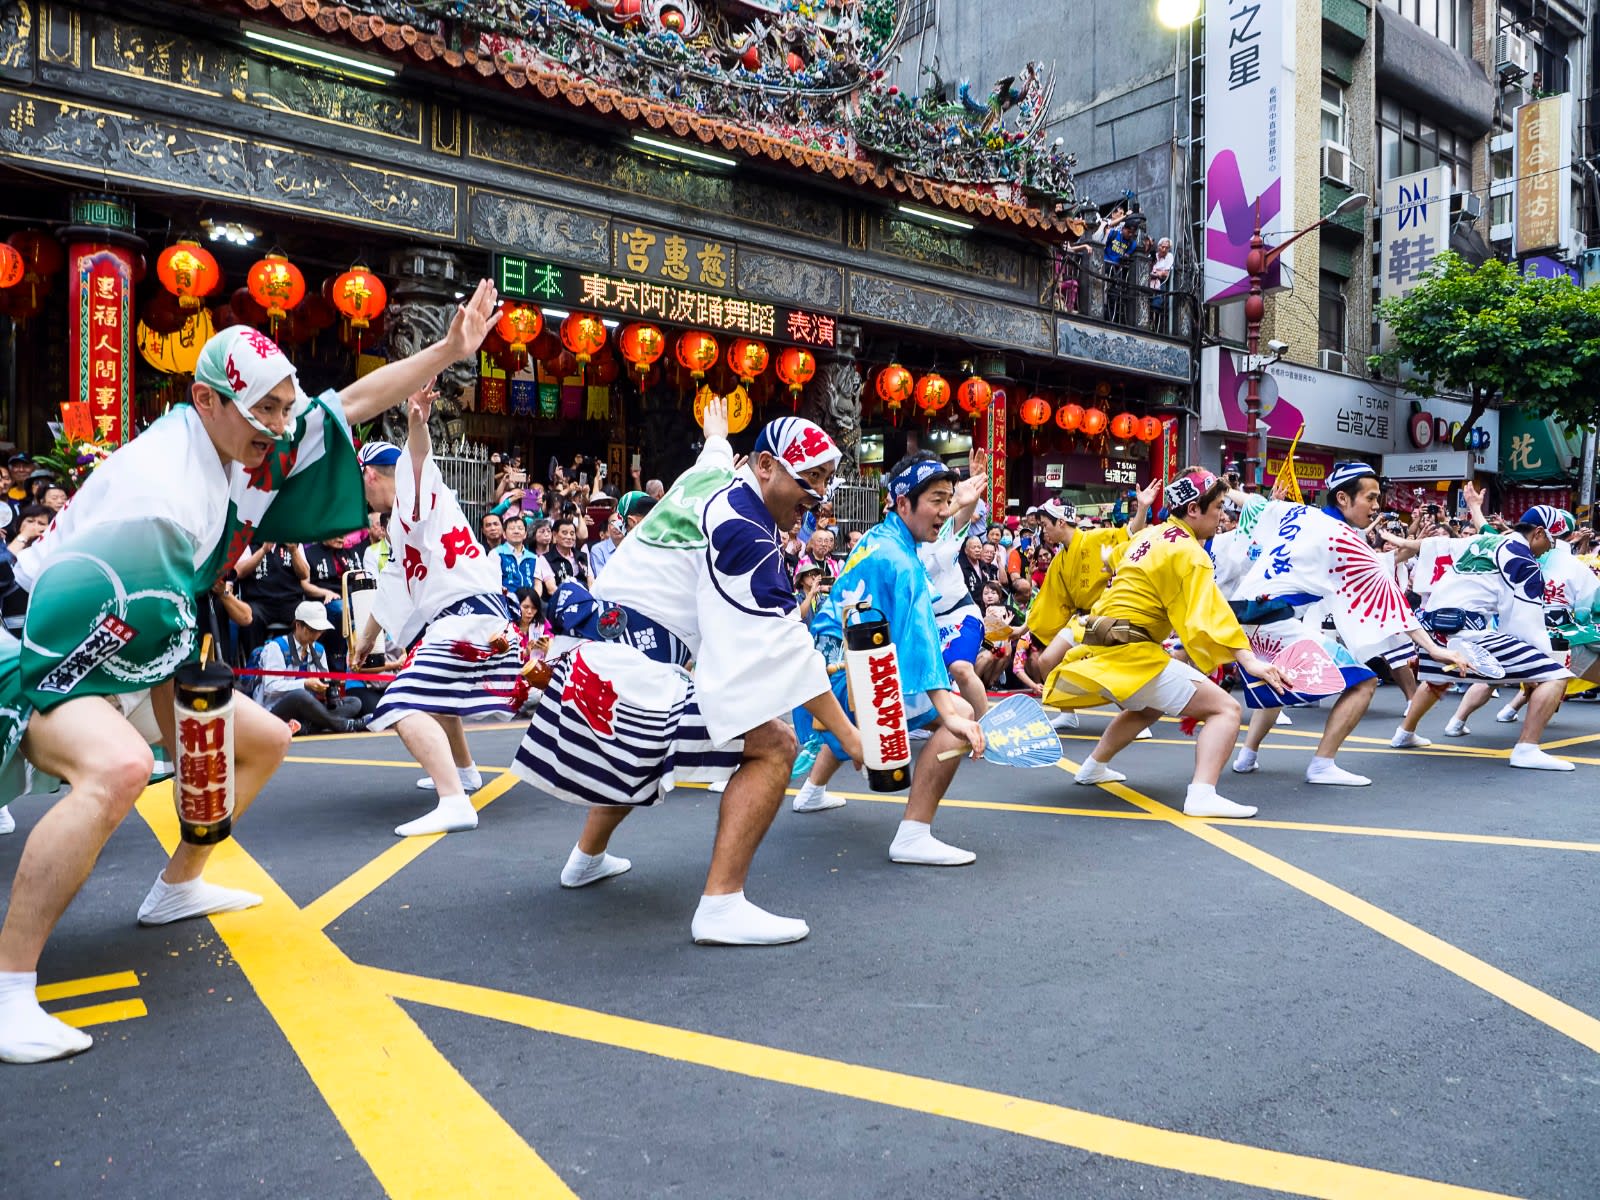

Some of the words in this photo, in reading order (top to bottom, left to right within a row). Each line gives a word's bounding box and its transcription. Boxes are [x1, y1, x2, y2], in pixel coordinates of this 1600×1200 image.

[1229, 0, 1261, 91] 之星
[1388, 233, 1435, 285] 鞋
[502, 257, 564, 299] 日本
[579, 272, 775, 338] 東京阿波踊舞蹈
[786, 311, 837, 347] 表演
[1357, 395, 1364, 406] T
[1365, 396, 1389, 411] STAR
[1508, 433, 1542, 471] 花
